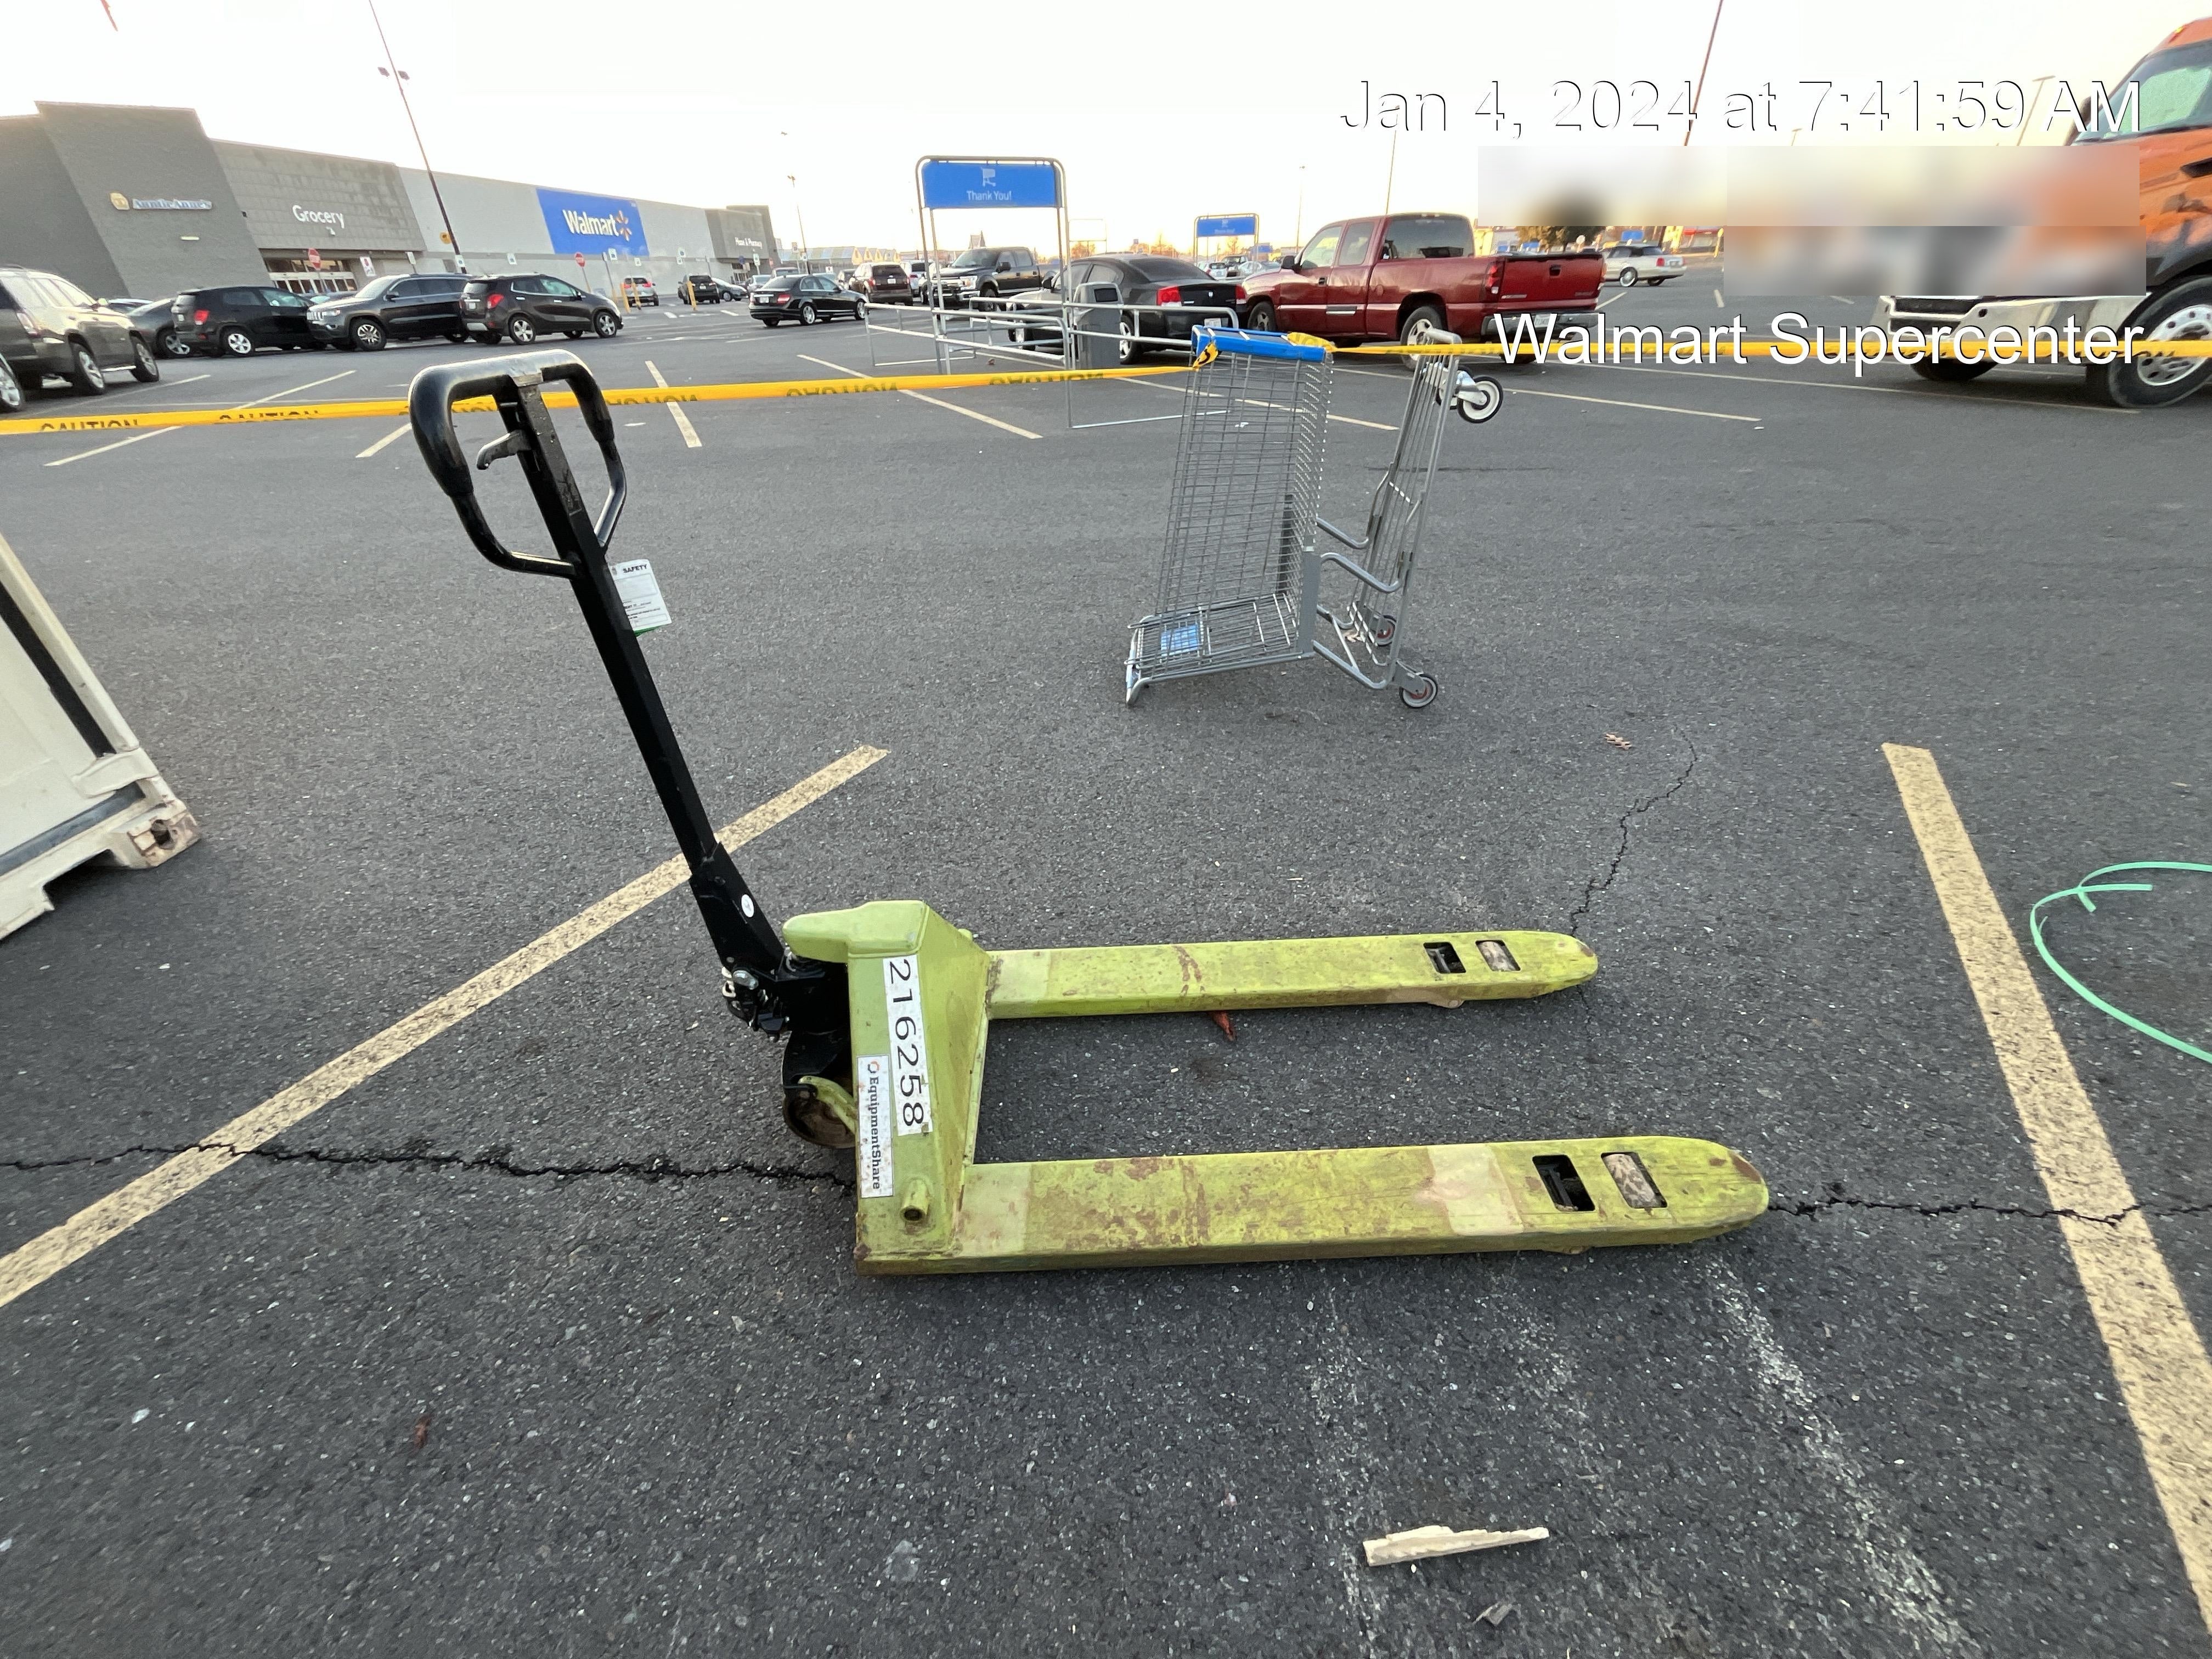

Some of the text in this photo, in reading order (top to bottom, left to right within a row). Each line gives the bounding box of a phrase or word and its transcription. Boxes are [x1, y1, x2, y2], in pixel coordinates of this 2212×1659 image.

[966, 190, 1012, 201] Thank You!
[292, 205, 345, 229] Grocery
[562, 209, 619, 236] Walmart
[623, 564, 647, 573] SAFETY
[889, 958, 924, 1127] 216258
[867, 1076, 882, 1190] EquipmentShare
